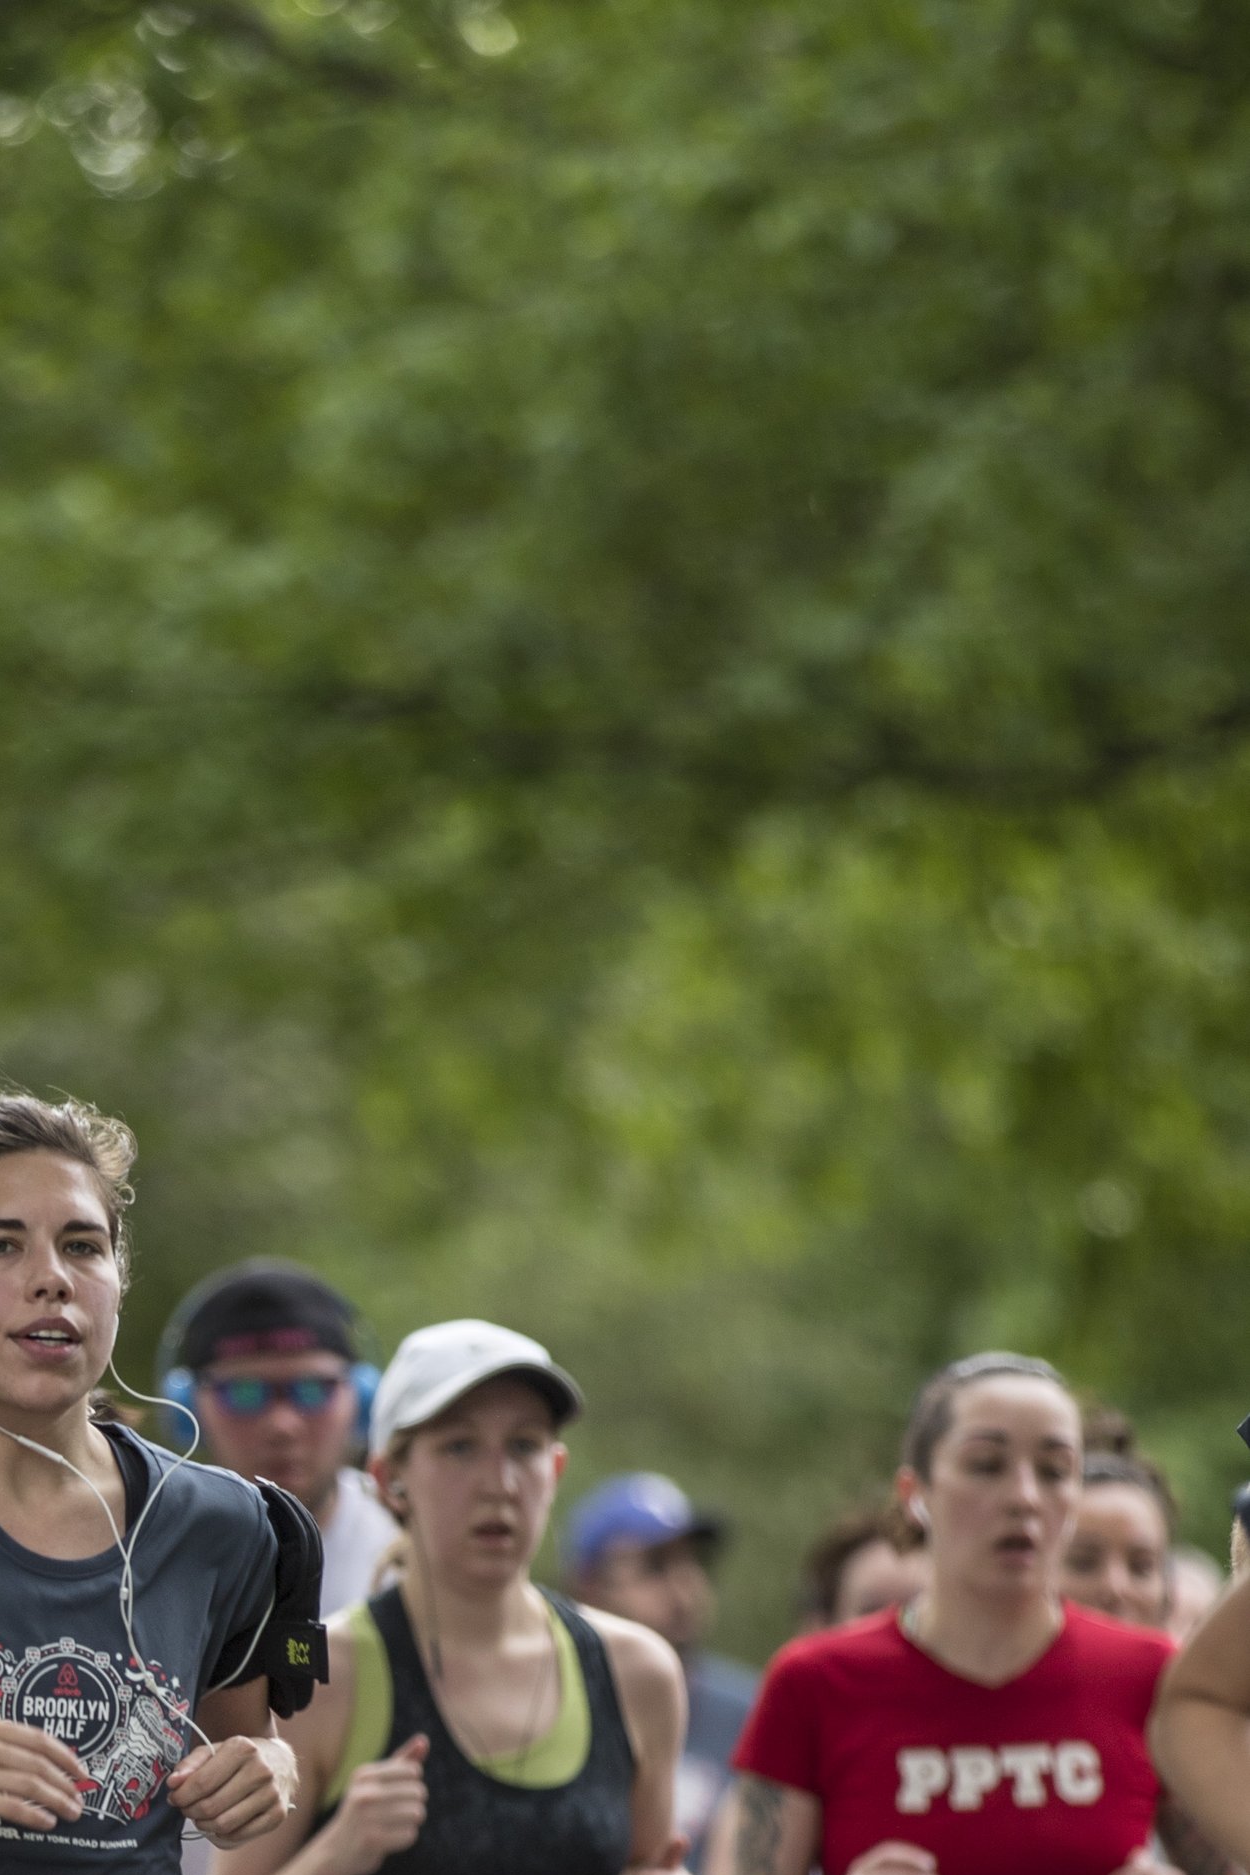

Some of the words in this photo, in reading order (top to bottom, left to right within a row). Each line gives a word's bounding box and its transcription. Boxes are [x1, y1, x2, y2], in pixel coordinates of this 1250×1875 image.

[22, 1695, 110, 1722] BROOKLYN
[43, 1717, 87, 1740] HALF
[895, 1740, 1104, 1816] PPTC
[23, 1831, 45, 1842] NEW
[47, 1834, 71, 1845] YORK
[71, 1837, 98, 1849] ROAD
[99, 1838, 139, 1850] RUNNERS
